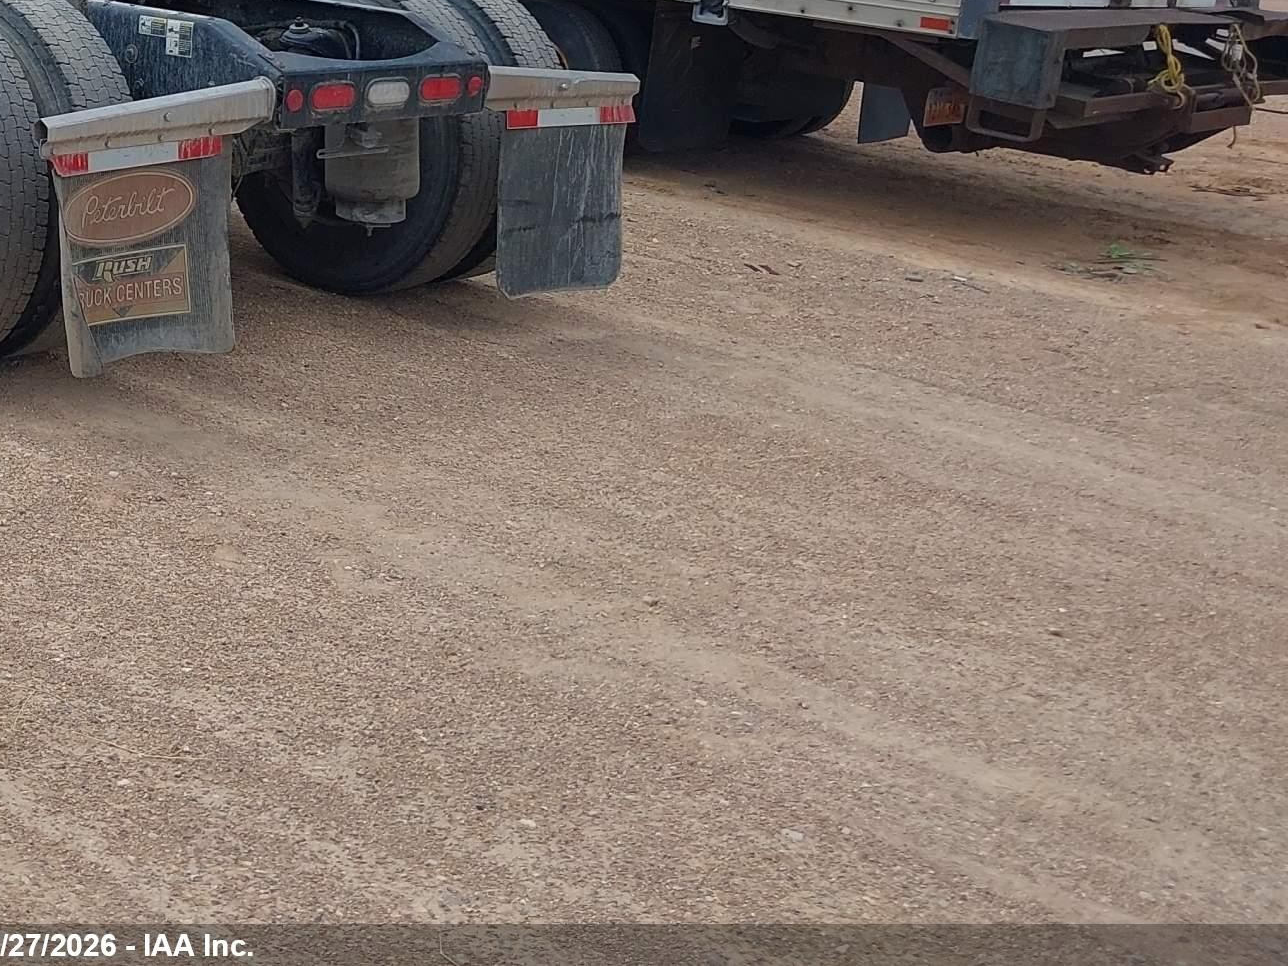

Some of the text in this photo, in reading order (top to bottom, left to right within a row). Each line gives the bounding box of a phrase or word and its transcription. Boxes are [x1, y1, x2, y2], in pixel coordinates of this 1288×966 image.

[81, 186, 175, 229] Peterbilt
[95, 255, 152, 283] RUSH
[78, 277, 183, 309] RUCK CENTERS
